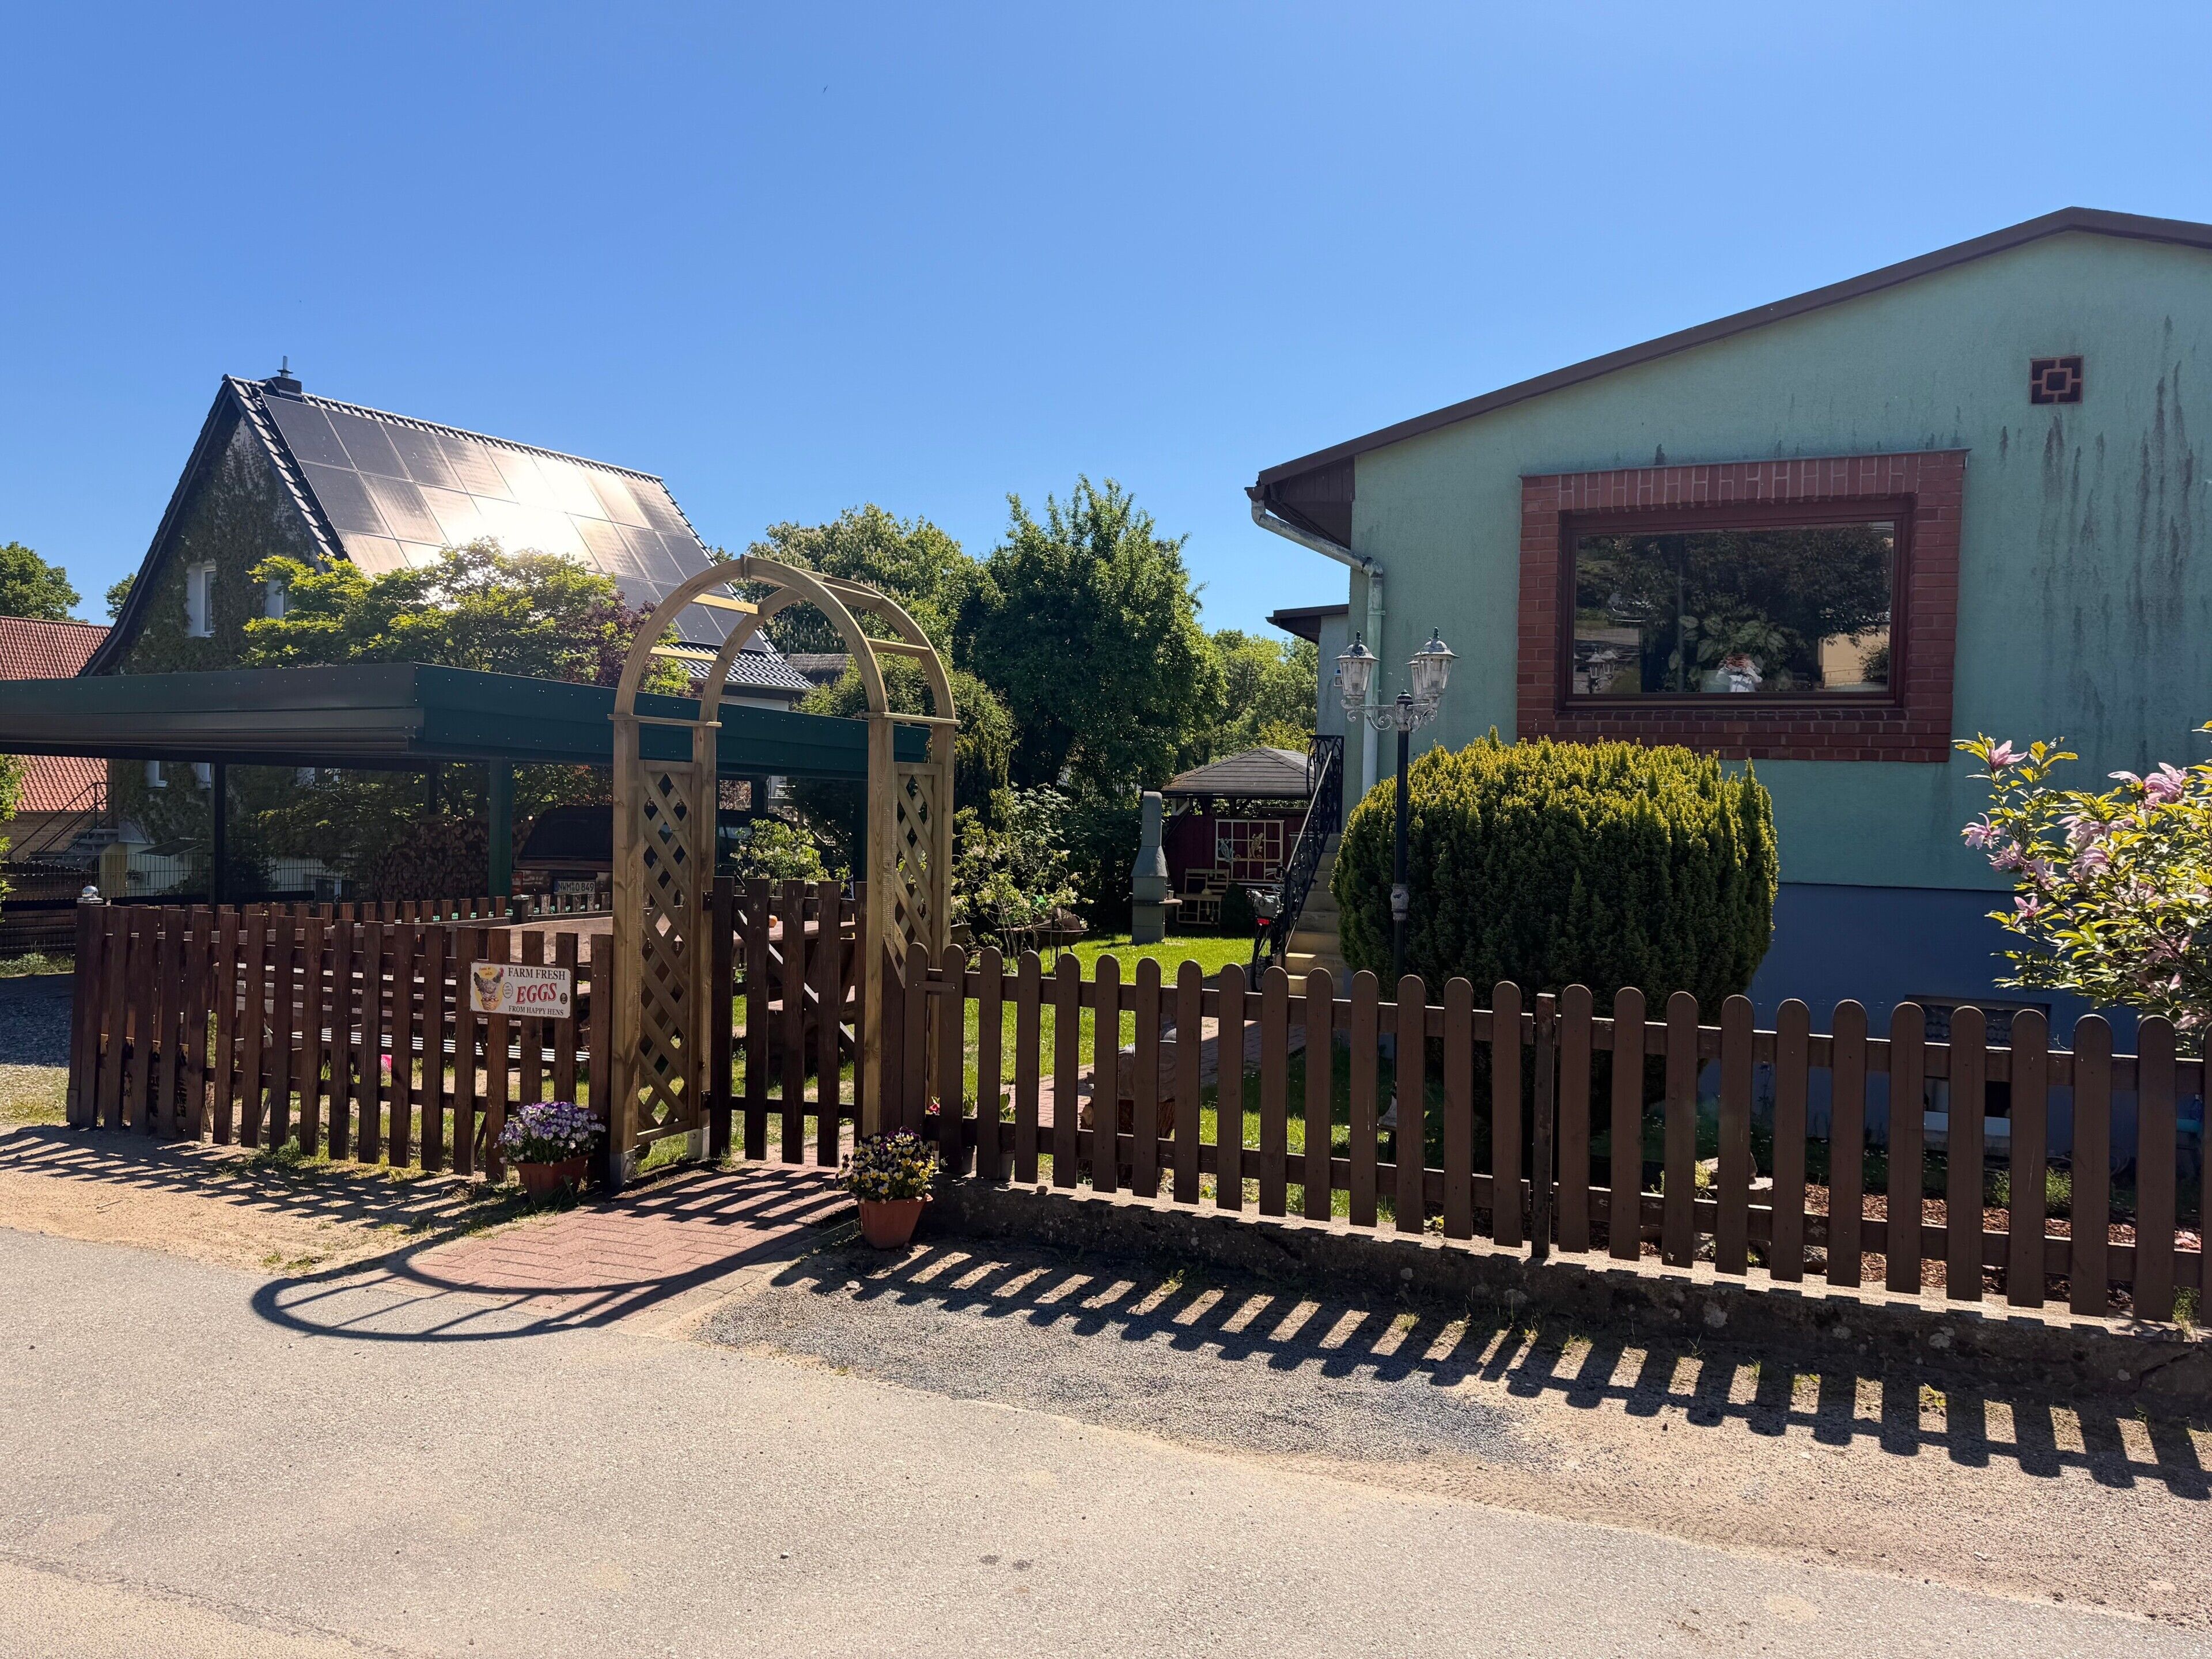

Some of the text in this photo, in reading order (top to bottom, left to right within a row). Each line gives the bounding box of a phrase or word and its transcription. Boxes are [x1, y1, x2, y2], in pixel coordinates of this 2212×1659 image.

[558, 882, 571, 891] NWM
[581, 882, 594, 891] 849
[508, 967, 566, 980] FARM FRESH
[516, 982, 557, 1005] EGGS
[509, 1005, 526, 1013] FROM
[527, 1007, 546, 1015] HAPPY
